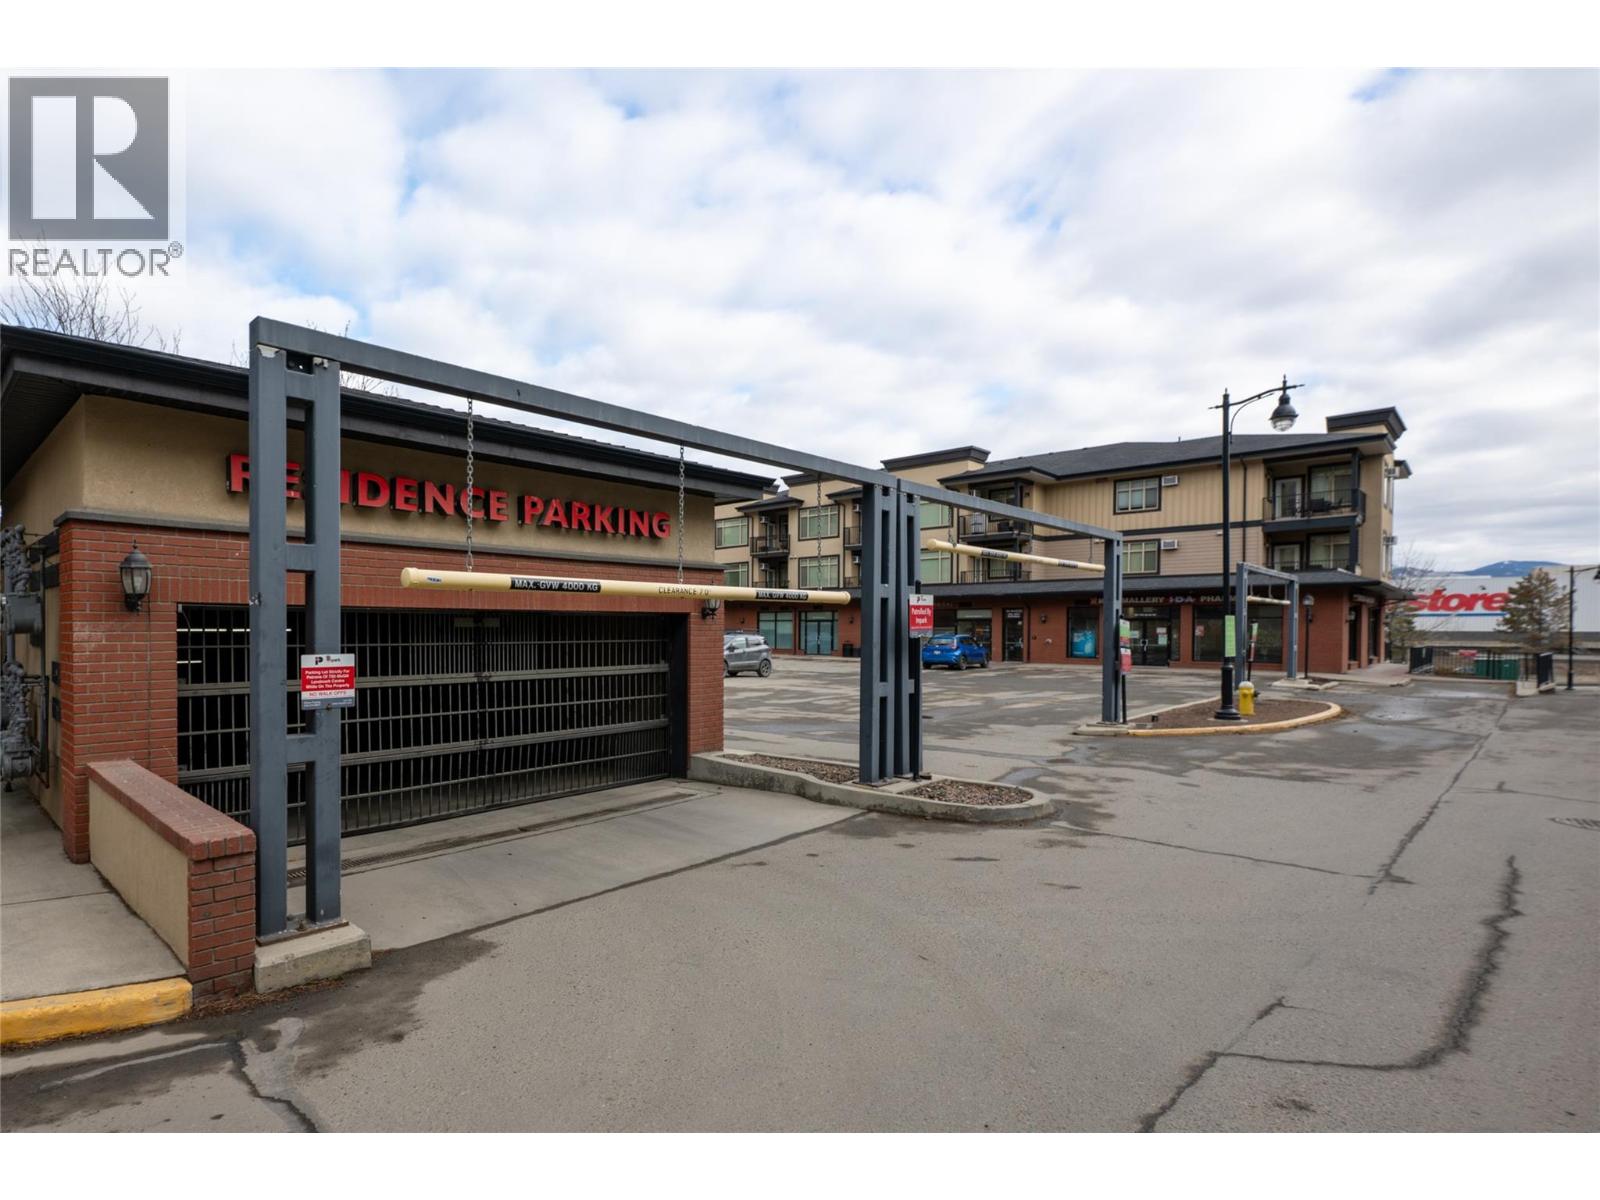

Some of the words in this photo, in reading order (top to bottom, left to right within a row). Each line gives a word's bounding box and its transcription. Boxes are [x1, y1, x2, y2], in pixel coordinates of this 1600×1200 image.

[228, 453, 509, 521] REIDENCE
[522, 494, 671, 540] PARKING
[539, 580, 560, 591] GVW
[562, 581, 585, 592] 4000
[586, 582, 598, 592] KG
[658, 587, 697, 596] CLEARANCE
